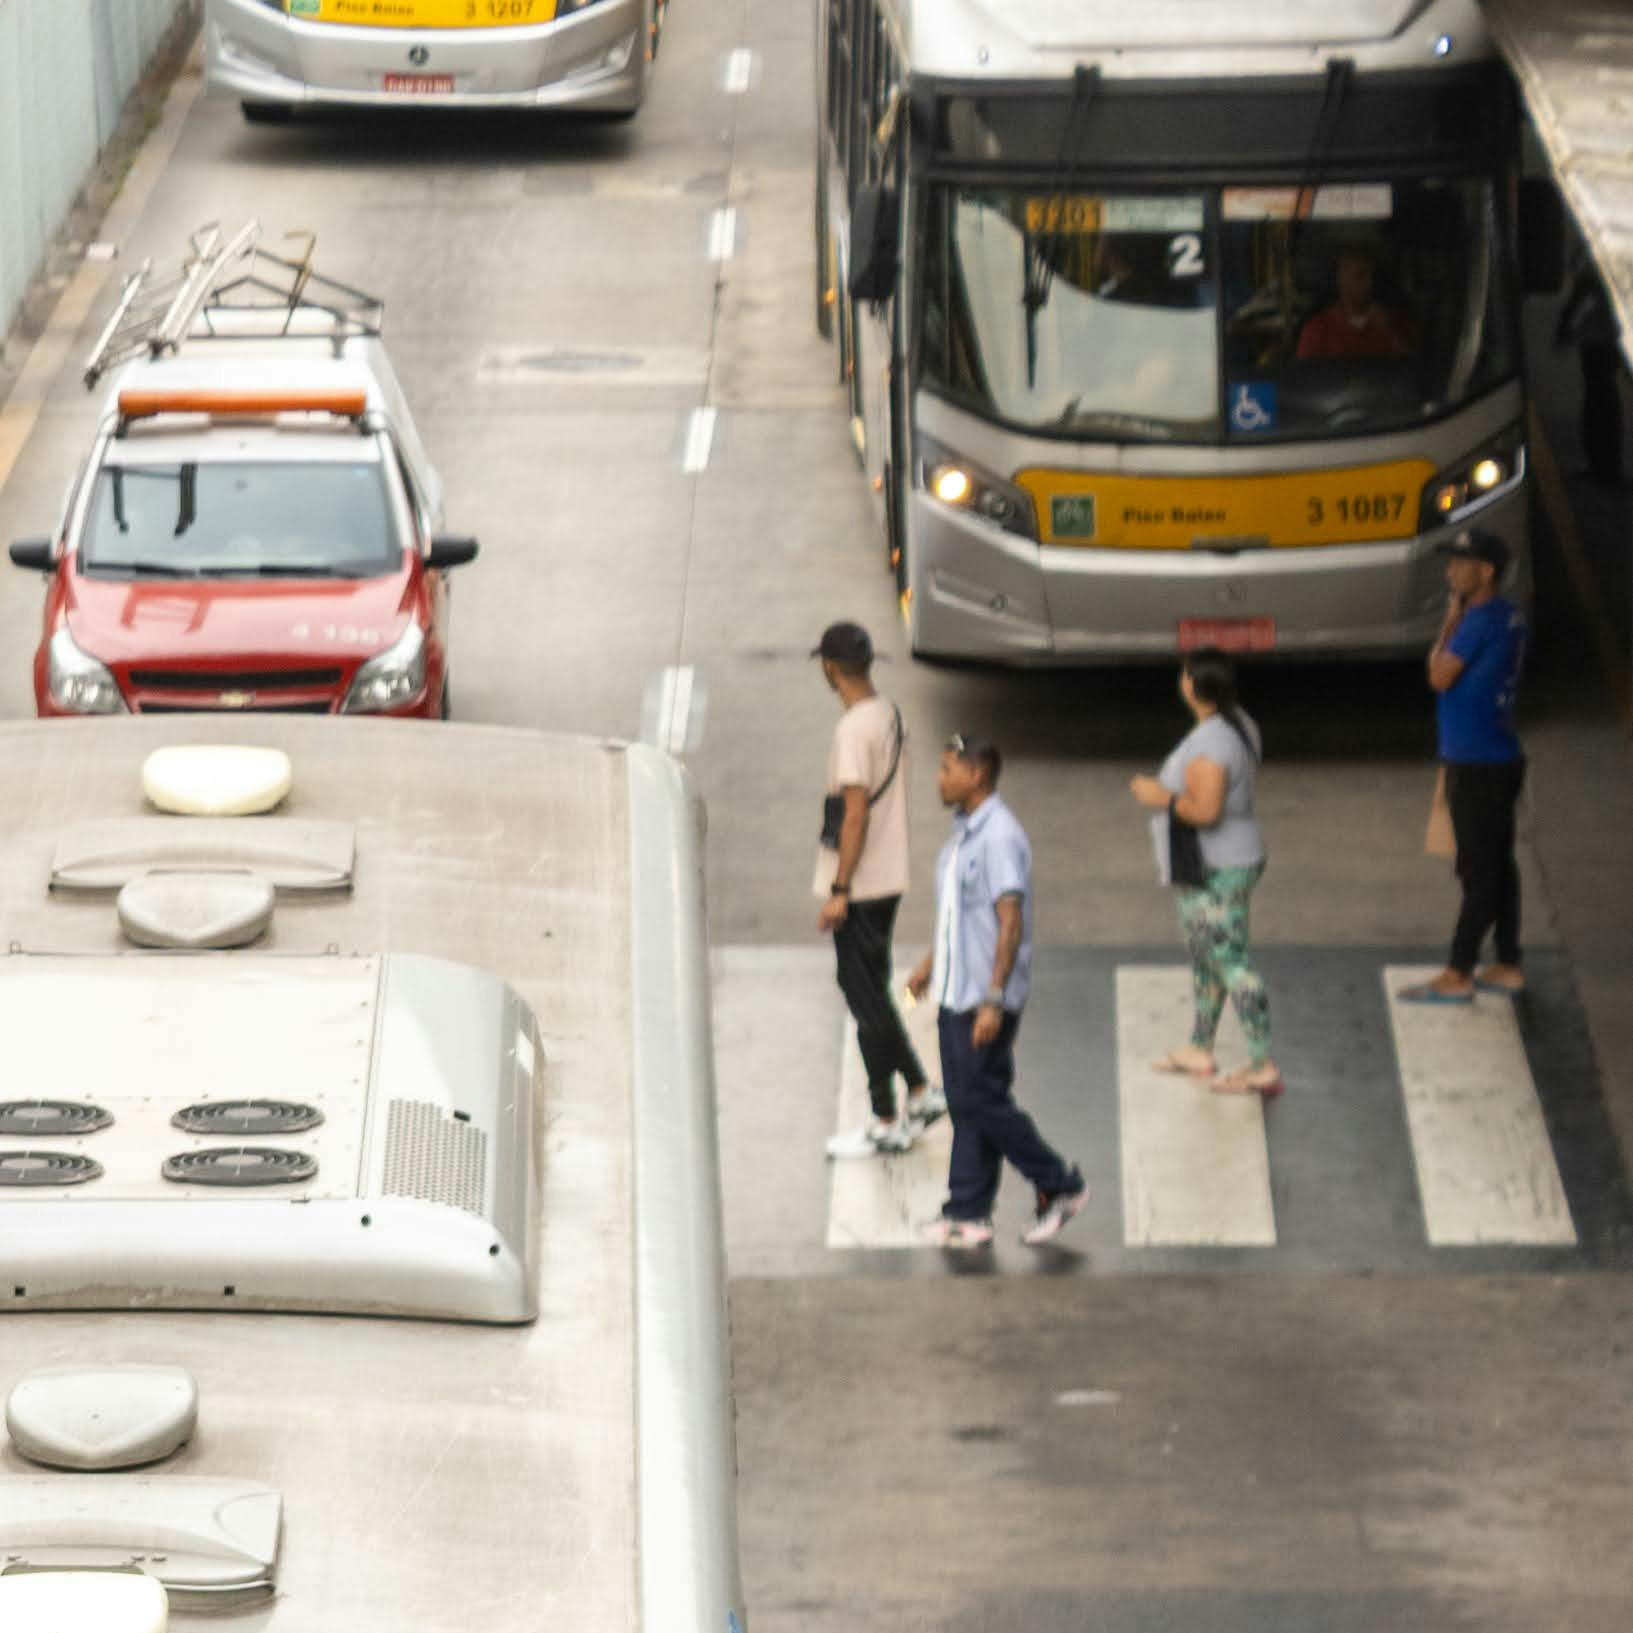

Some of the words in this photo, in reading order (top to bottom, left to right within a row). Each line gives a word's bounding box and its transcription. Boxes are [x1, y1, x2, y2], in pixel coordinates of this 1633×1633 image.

[1170, 234, 1204, 277] 2
[1307, 496, 1324, 527] 3
[1336, 494, 1407, 524] 1087
